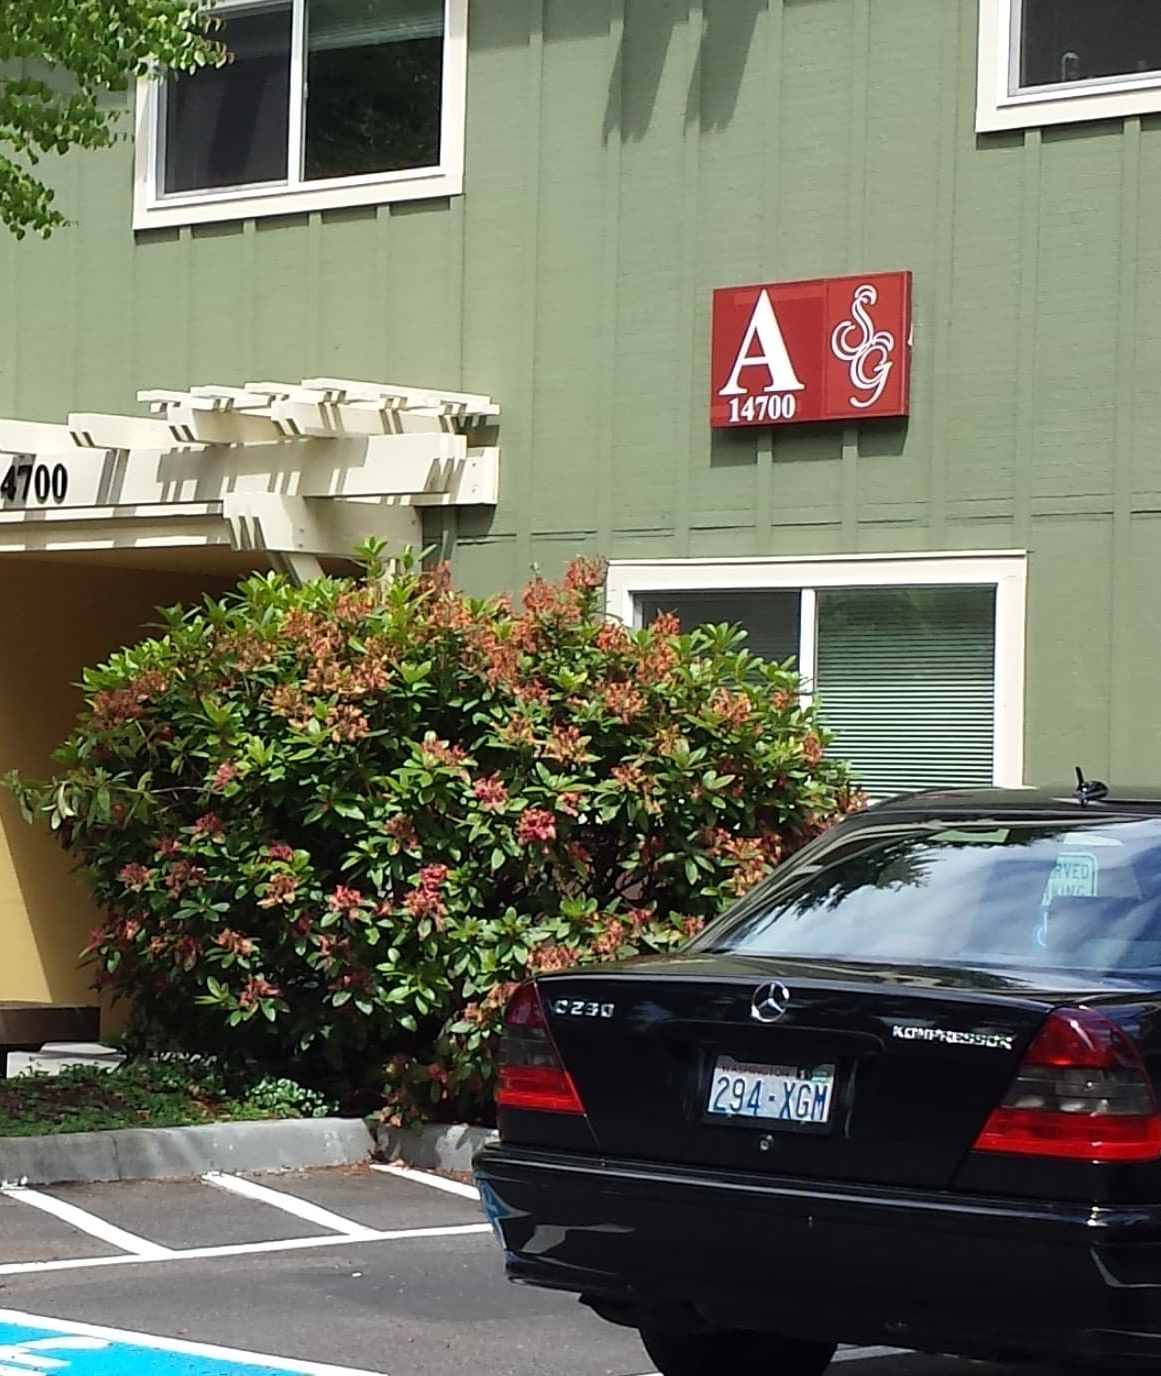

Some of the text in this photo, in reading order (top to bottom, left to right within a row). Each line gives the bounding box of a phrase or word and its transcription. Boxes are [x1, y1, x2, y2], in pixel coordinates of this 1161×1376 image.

[718, 288, 806, 396] A
[729, 394, 796, 422] 14700
[892, 1025, 1013, 1050] KOMPRESSOR
